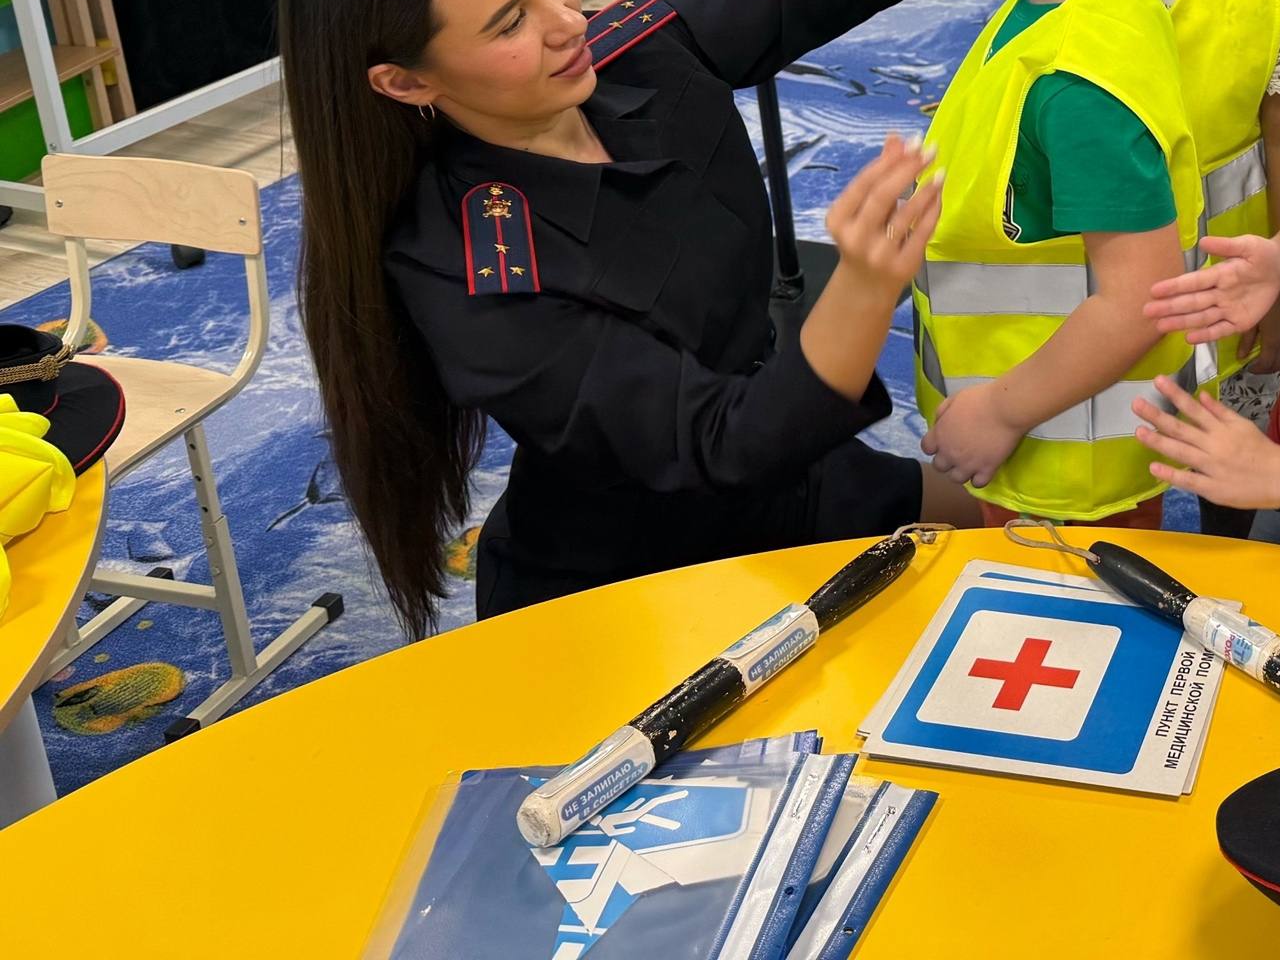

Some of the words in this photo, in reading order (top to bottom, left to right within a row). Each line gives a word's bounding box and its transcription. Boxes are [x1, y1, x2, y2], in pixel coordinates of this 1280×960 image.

[751, 665, 764, 678] НЕ
[763, 631, 803, 668] ЗАЛИПАЮ
[1155, 700, 1178, 738] ПУНКТ
[1170, 651, 1196, 696] ПЕРВОЙ
[1164, 682, 1205, 770] МЕДИЦИНСКОЙ
[564, 802, 580, 818] НЕ
[580, 763, 631, 805] ЗАЛИПАЮ
[593, 766, 644, 809] СОЦСЕТЯХ
